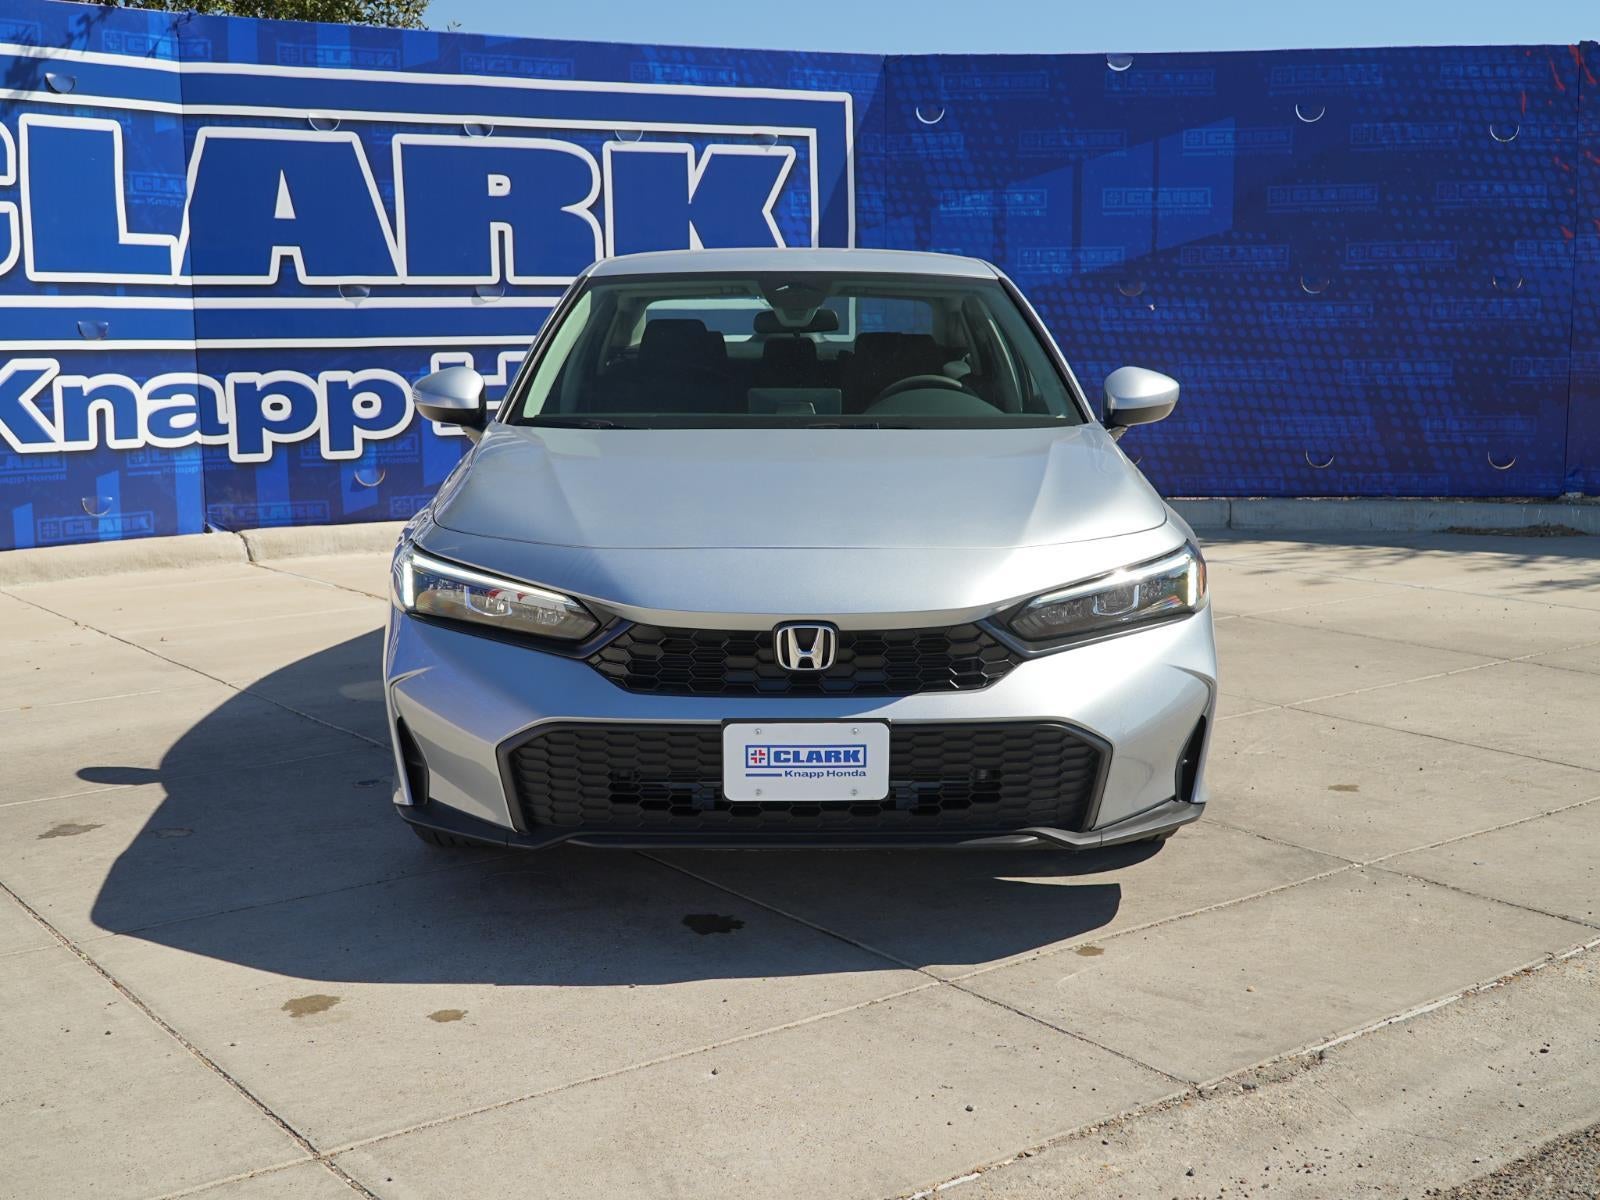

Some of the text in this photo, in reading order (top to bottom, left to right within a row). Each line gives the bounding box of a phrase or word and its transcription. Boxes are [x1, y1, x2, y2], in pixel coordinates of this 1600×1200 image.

[0, 113, 796, 284] LARK
[64, 515, 150, 535] CLARK
[773, 750, 860, 763] CLARK
[784, 769, 867, 779] Knapp Honda
